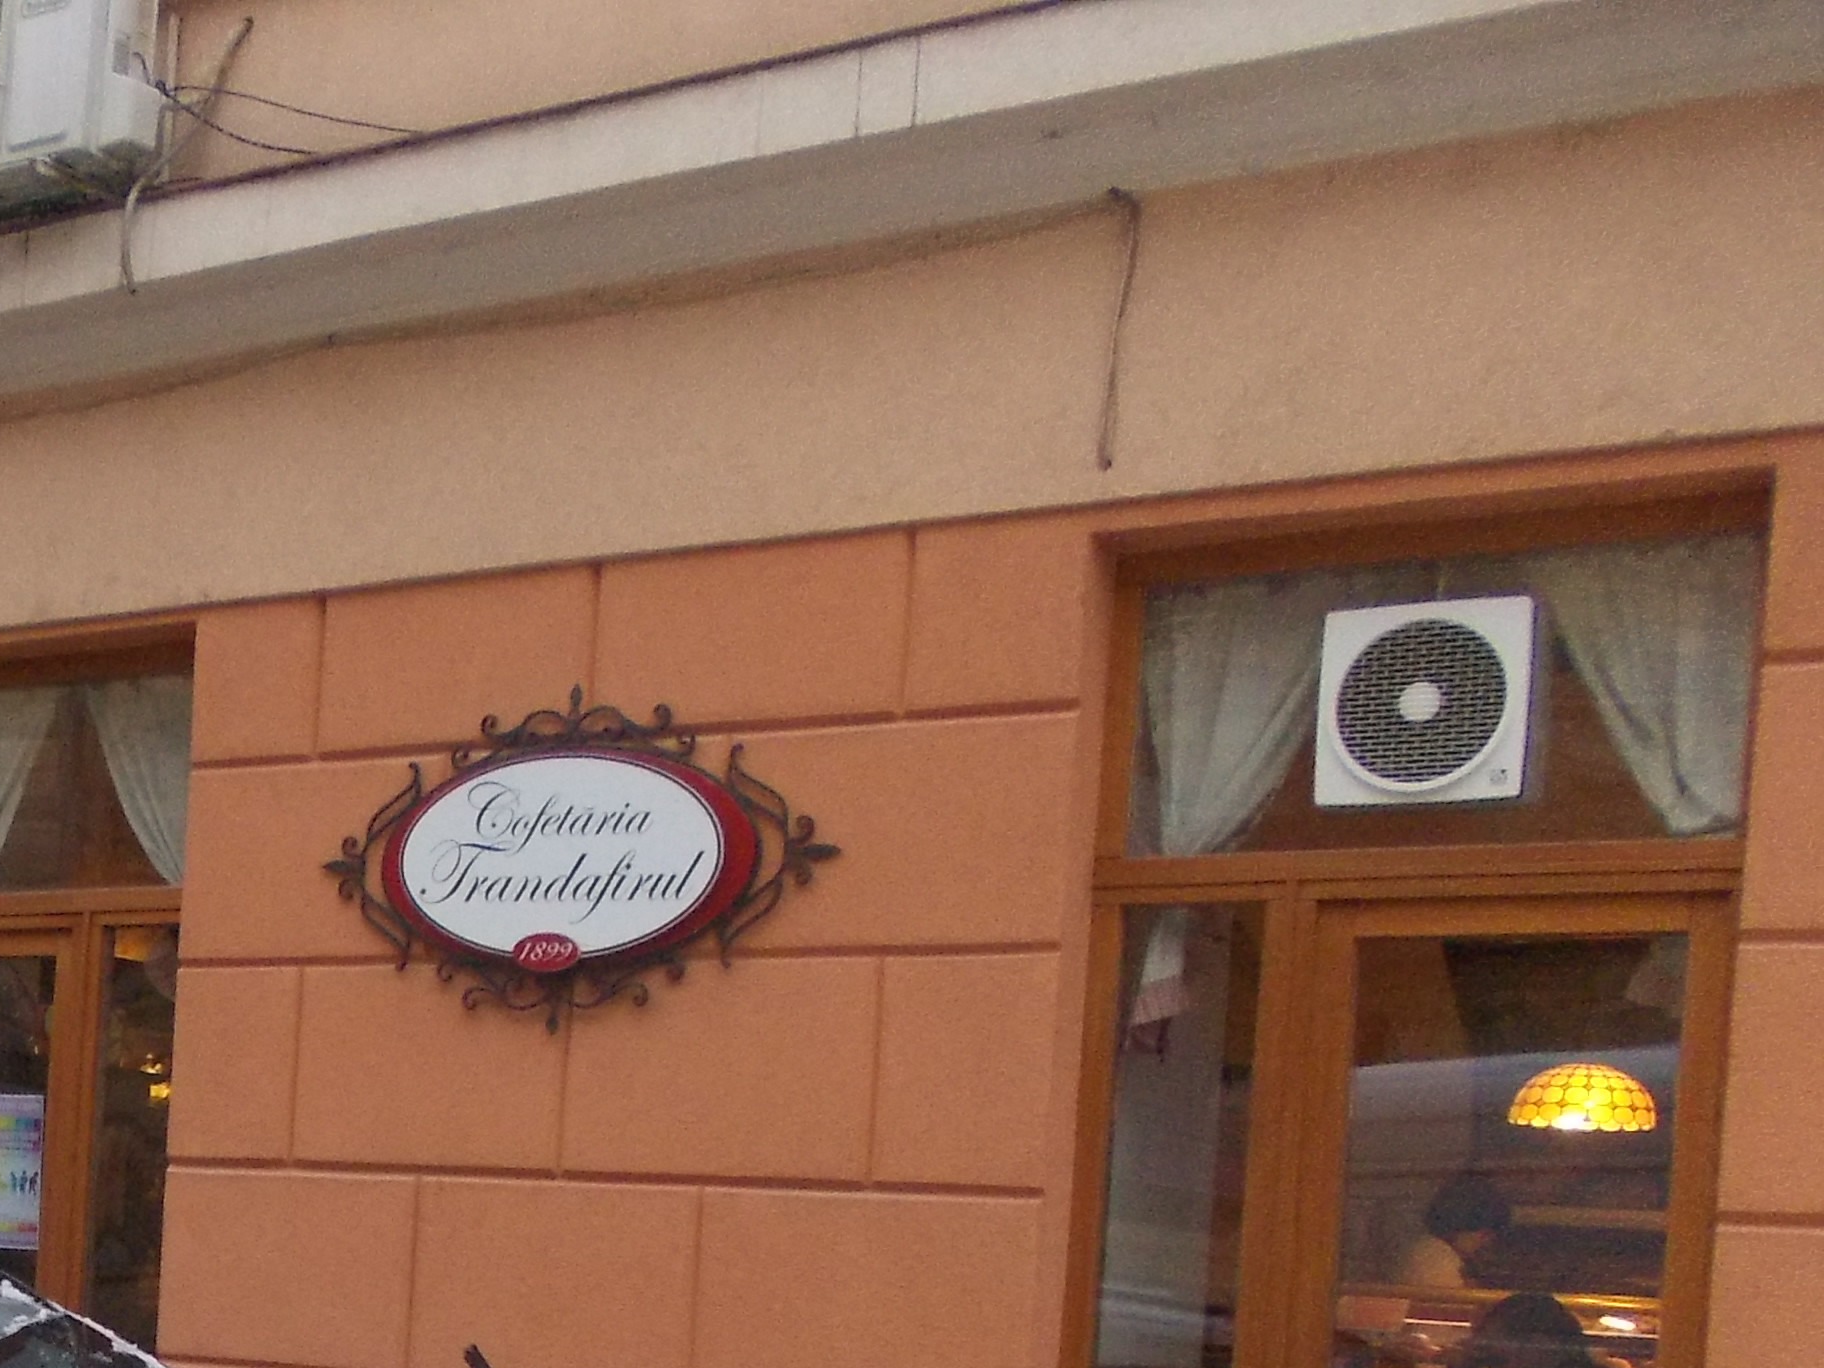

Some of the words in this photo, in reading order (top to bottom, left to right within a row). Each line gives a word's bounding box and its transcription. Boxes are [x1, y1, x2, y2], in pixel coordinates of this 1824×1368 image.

[467, 780, 653, 856] Cofetăria
[419, 839, 706, 924] Trandafirul
[515, 940, 575, 962] 1899
